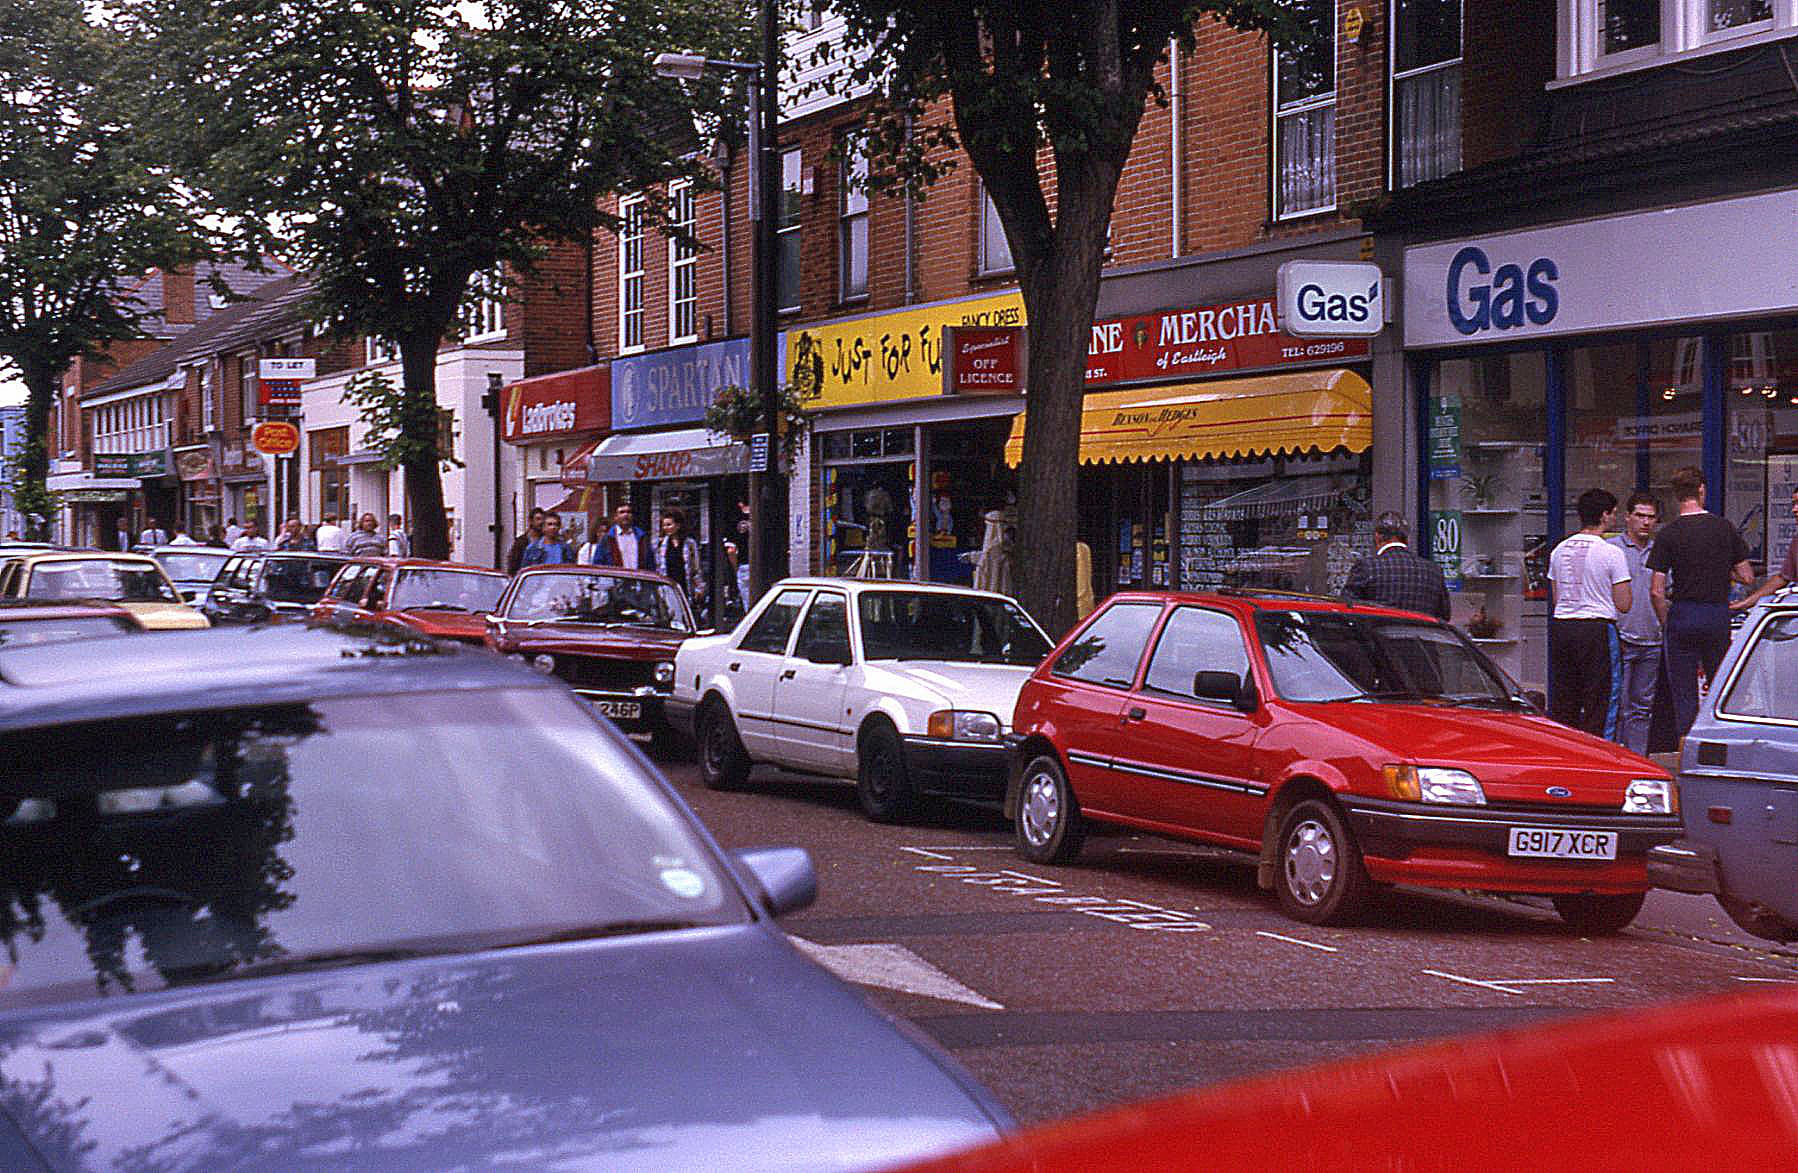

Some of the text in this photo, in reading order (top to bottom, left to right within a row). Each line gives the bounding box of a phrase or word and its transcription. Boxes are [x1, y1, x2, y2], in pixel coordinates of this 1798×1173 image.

[1297, 284, 1369, 321] Gas
[1447, 246, 1559, 335] Gas
[994, 307, 1020, 326] DRESS
[1088, 322, 1123, 355] NE
[1281, 342, 1345, 358] TEL: 629196
[271, 361, 304, 369] TO LET
[832, 337, 872, 385] JUST
[881, 334, 910, 380] FOR
[974, 359, 999, 369] OFF
[1156, 346, 1227, 370] of Eastleigh
[647, 352, 752, 413] SPARTAN
[960, 373, 1015, 384] LICENCE
[1438, 518, 1459, 553] 80
[1516, 831, 1609, 855] G917 XCR
